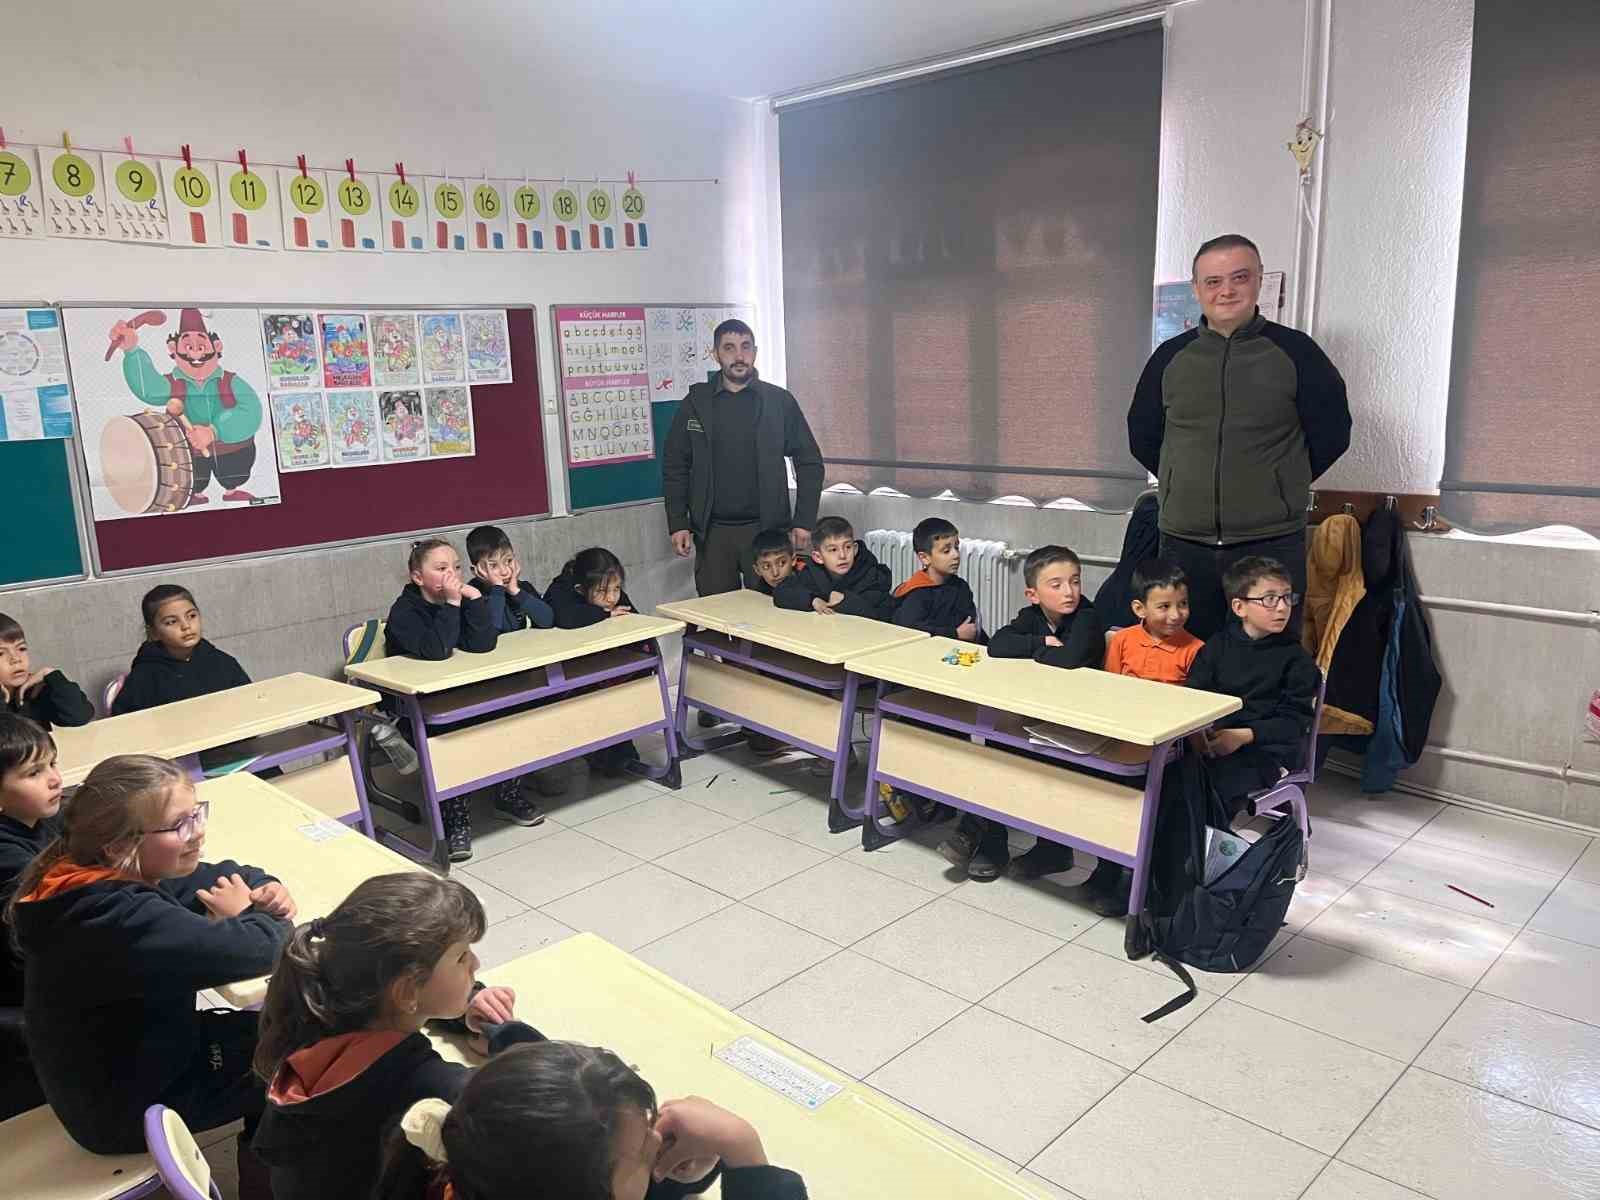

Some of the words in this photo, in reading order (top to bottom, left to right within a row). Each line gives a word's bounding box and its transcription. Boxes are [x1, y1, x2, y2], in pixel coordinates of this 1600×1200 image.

[0, 161, 16, 186] 7
[66, 164, 81, 188] 8
[128, 170, 143, 193] 9
[180, 175, 204, 199] 10
[241, 179, 256, 202] 11
[297, 184, 318, 206] 12
[345, 186, 364, 208] 13
[394, 189, 414, 209] 14
[440, 191, 458, 211] 15
[479, 192, 496, 211] 16
[520, 193, 535, 212] 17
[558, 196, 573, 215] 18
[592, 195, 606, 213] 19
[625, 195, 644, 213] 20
